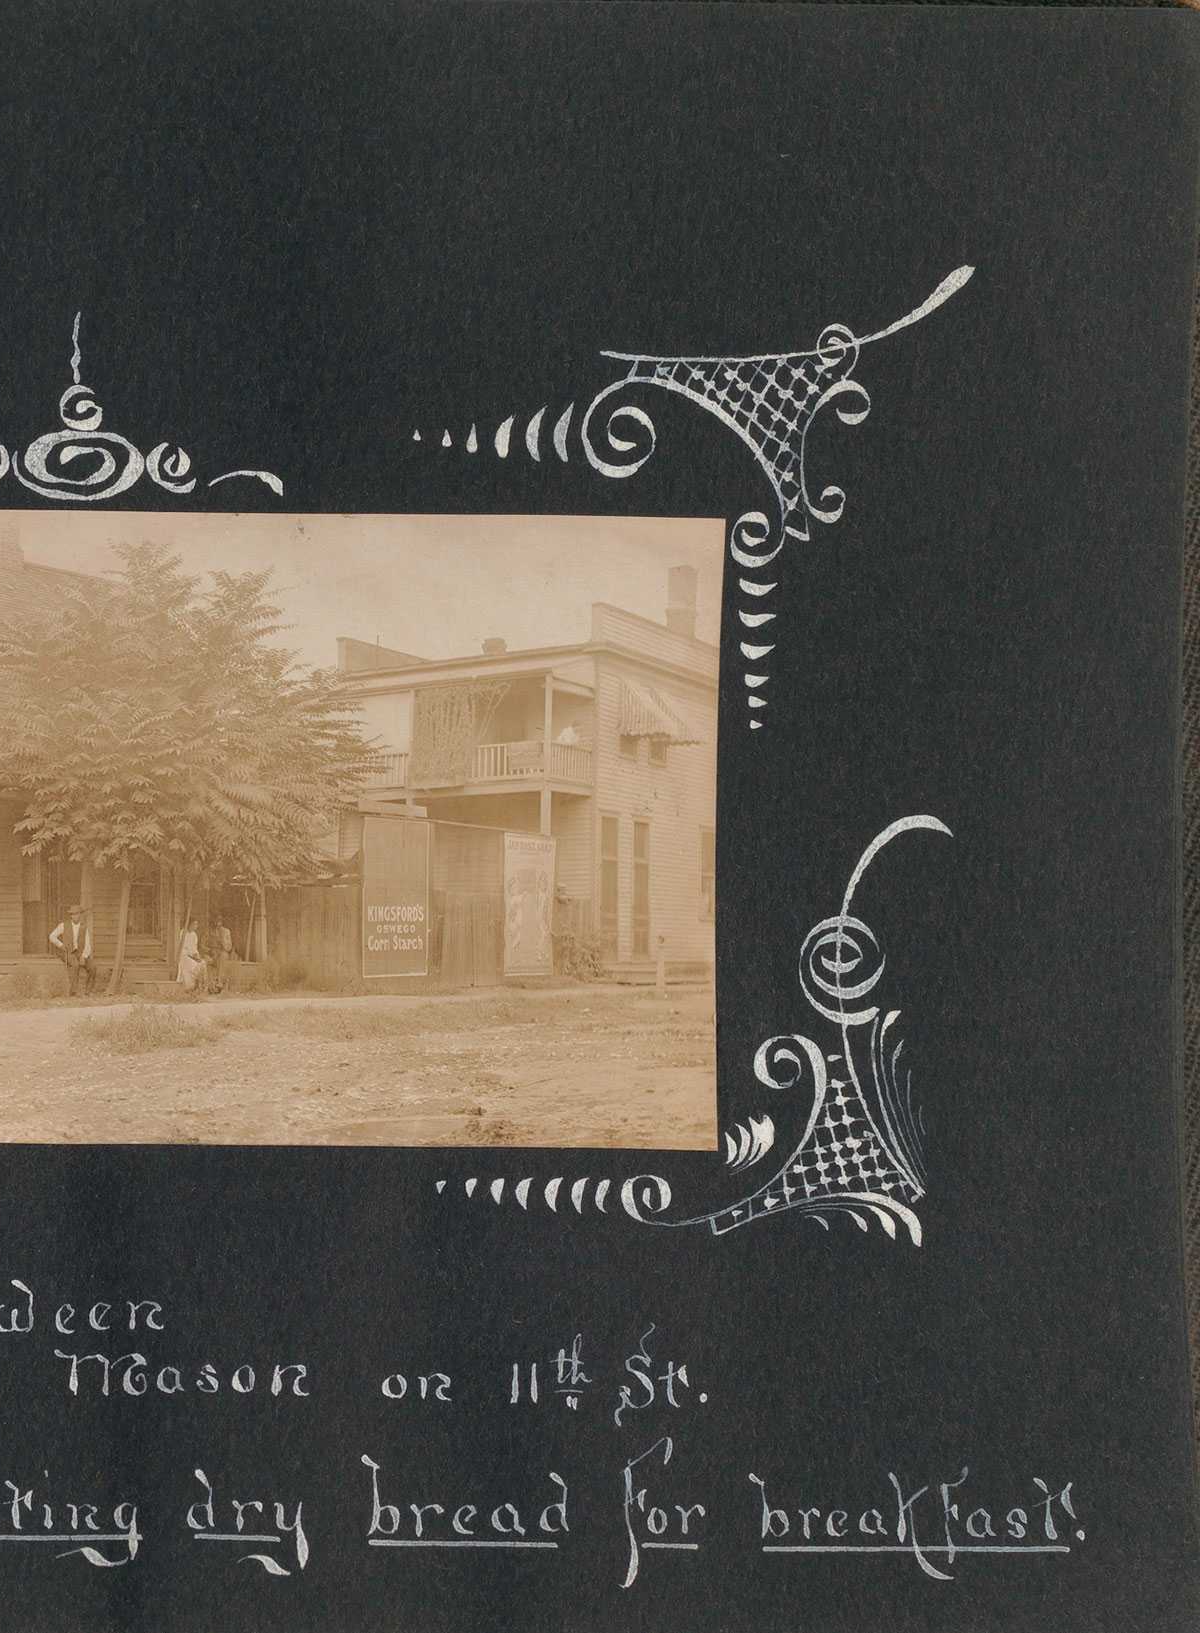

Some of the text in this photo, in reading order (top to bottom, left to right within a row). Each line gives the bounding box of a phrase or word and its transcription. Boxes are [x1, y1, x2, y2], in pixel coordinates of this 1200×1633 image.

[367, 935, 424, 951] Corn Starch
[376, 924, 416, 934] OSWEGO
[54, 1348, 311, 1400] Mason
[381, 1371, 453, 1402] on
[614, 1322, 709, 1428] St.
[185, 1468, 311, 1576] dry
[361, 1454, 570, 1539] bread
[618, 1436, 708, 1589] for
